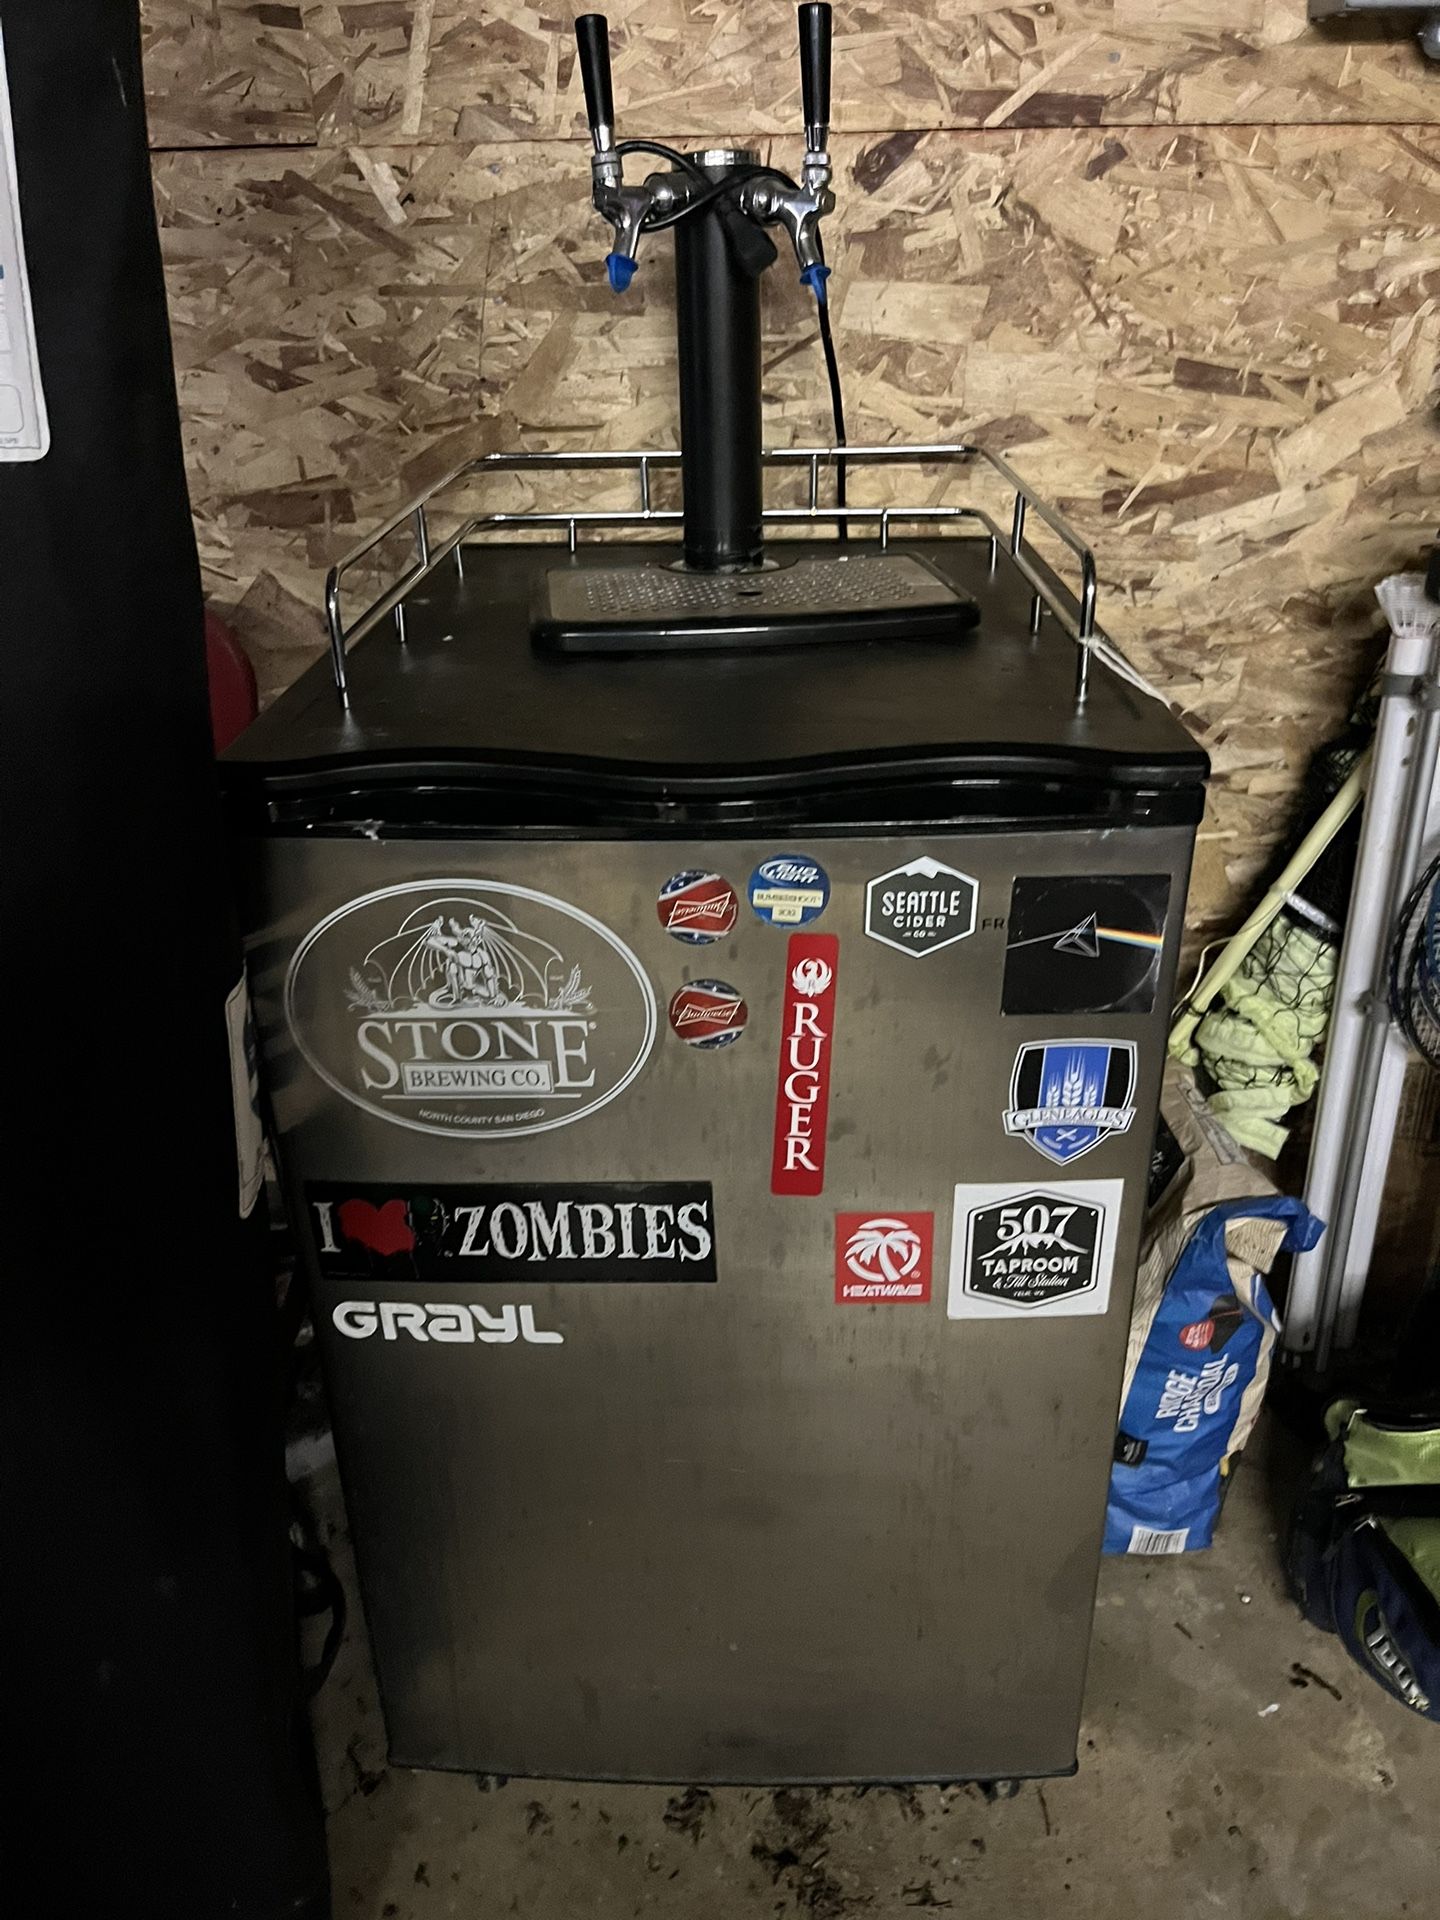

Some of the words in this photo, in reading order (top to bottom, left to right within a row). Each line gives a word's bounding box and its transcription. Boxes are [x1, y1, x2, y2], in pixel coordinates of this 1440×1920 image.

[766, 869, 820, 884] LIGHT
[776, 863, 818, 876] BUD
[881, 890, 961, 916] SEATTLE
[893, 915, 946, 928] CIDER
[356, 1019, 597, 1091] STONE
[410, 1069, 506, 1087] BREWING
[511, 1069, 546, 1086] CO.
[783, 1001, 828, 1171] RUGER
[418, 1108, 452, 1123] NORTH
[453, 1114, 493, 1124] COUNTY
[495, 1114, 515, 1124] SAN
[515, 1108, 545, 1121] DIEGO
[313, 1201, 342, 1254] I
[454, 1199, 713, 1263] ZOMBIES
[996, 1203, 1079, 1241] 507
[982, 1255, 1079, 1277] TAPROOM
[842, 1283, 924, 1297] HEATWAVE
[992, 1276, 1003, 1289] &
[1027, 1272, 1070, 1288] Station
[332, 1300, 565, 1344] GRAYL
